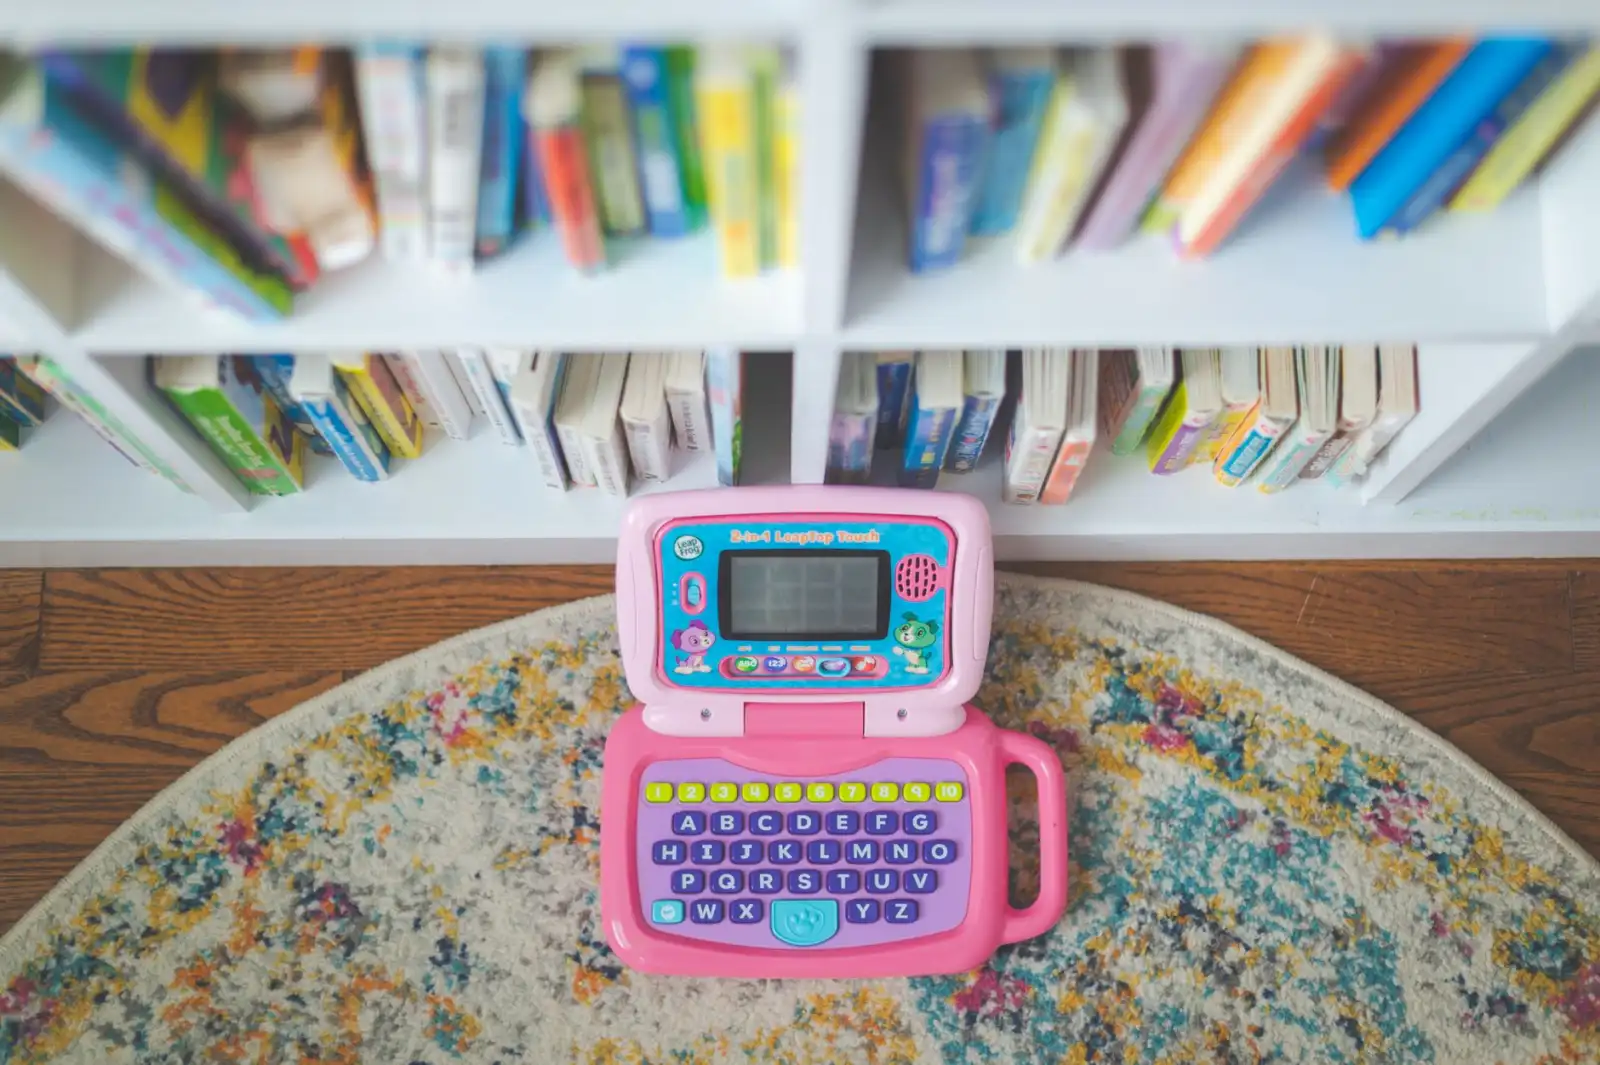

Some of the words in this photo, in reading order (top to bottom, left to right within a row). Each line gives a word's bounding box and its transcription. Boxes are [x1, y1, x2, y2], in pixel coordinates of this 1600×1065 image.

[677, 538, 698, 548] Leap
[730, 529, 771, 543] 2-in-1
[774, 530, 834, 545] LeapTop
[836, 529, 880, 543] Touch
[680, 547, 700, 555] Frog
[768, 658, 785, 667] 123
[654, 786, 661, 798] 1
[686, 786, 696, 799] 2
[718, 786, 728, 798] 3
[750, 786, 761, 798] 4
[783, 786, 792, 799] 5
[815, 786, 825, 798] 6
[848, 785, 857, 798] 7
[879, 785, 889, 798] 8
[911, 785, 922, 798] 9
[942, 785, 957, 797] 10
[680, 815, 696, 831] A
[720, 815, 734, 830] B
[758, 815, 772, 831] C
[797, 815, 811, 829] D
[837, 815, 848, 830] E
[876, 815, 887, 829] F
[912, 814, 928, 830] G
[662, 845, 677, 860] H
[702, 845, 712, 859] I
[741, 844, 752, 859] J
[778, 844, 792, 859] K
[820, 844, 829, 859] L
[853, 844, 871, 859] M
[893, 844, 908, 858] N
[931, 844, 948, 859] O
[682, 874, 695, 889] P
[718, 874, 735, 889] Q
[760, 874, 773, 889] R
[798, 873, 811, 889] S
[837, 874, 850, 889] T
[874, 873, 890, 889] U
[913, 873, 928, 888] V
[697, 904, 716, 919] W
[739, 904, 754, 919] X
[856, 904, 870, 918] Y
[895, 903, 908, 919] Z
